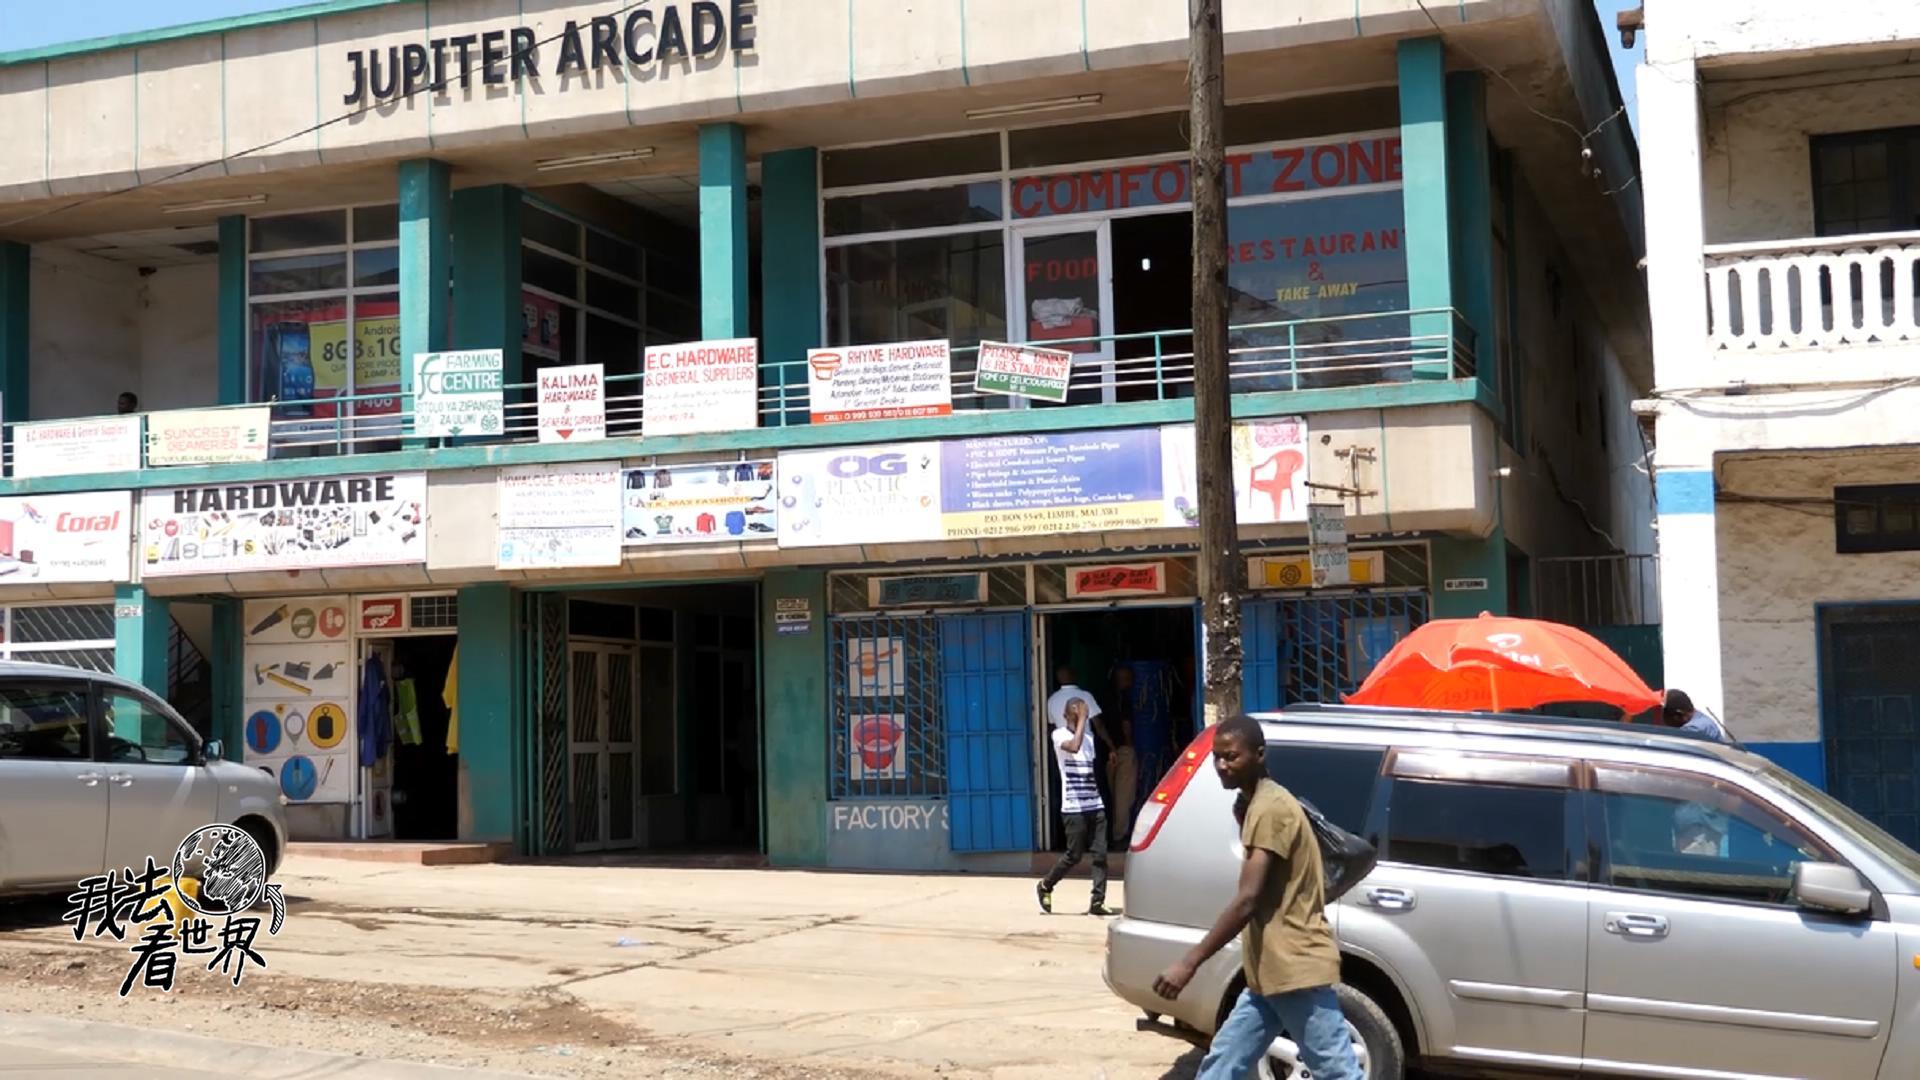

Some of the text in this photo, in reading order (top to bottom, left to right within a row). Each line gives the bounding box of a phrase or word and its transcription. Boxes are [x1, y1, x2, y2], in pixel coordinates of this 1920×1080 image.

[343, 0, 756, 106] JUPITER ARCADE
[1011, 152, 1257, 218] COMFOT
[1028, 258, 1098, 283] FOOD
[1307, 261, 1324, 281] &
[1276, 282, 1358, 302] TAKE AWAY
[367, 347, 376, 358] &
[446, 353, 500, 369] FARMING
[646, 346, 754, 370] E.C. HARDWARE
[847, 344, 946, 364] RHYME HARDWARE
[443, 373, 500, 391] CENTRE
[542, 373, 599, 390] KALIMA
[655, 369, 699, 386] GENERAL
[703, 366, 754, 383] SUPPLIERS
[543, 388, 598, 403] HARDWARE
[163, 426, 241, 441] SUNCREST
[827, 453, 908, 479] OG
[174, 475, 395, 514] HARDWARE
[827, 475, 910, 496] PLASTIC
[668, 499, 694, 507] MAX
[696, 495, 752, 505] FASHIONS
[55, 510, 120, 532] Coral
[1002, 513, 1021, 521] BOX
[834, 804, 937, 831] FACTORY
